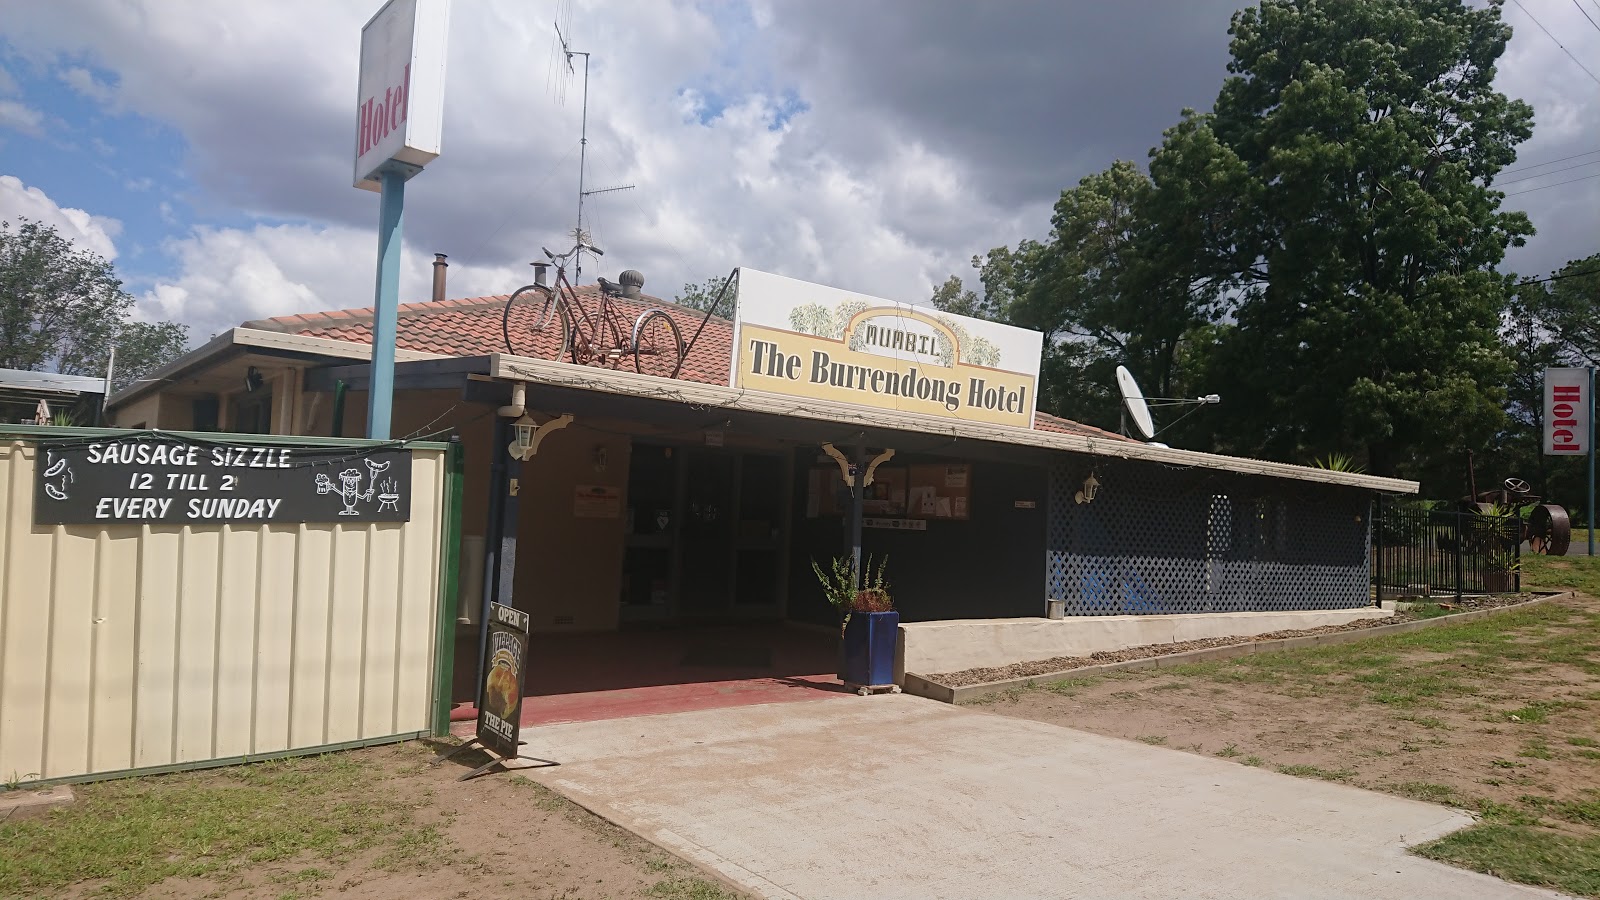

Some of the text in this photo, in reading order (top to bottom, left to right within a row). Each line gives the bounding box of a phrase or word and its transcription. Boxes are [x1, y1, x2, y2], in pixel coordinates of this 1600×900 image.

[358, 62, 410, 158] Hotel
[865, 324, 940, 357] MUMBIL
[750, 339, 1026, 414] The Burrendong Hotel
[1552, 385, 1581, 451] Hotel
[87, 444, 291, 468] SAUSAGE SIZZLE
[129, 473, 235, 491] 12 TILL 2
[95, 497, 282, 519] EVERY SUNDAY
[498, 606, 521, 627] OPEN
[484, 711, 500, 729] THE
[500, 719, 514, 739] PIE
